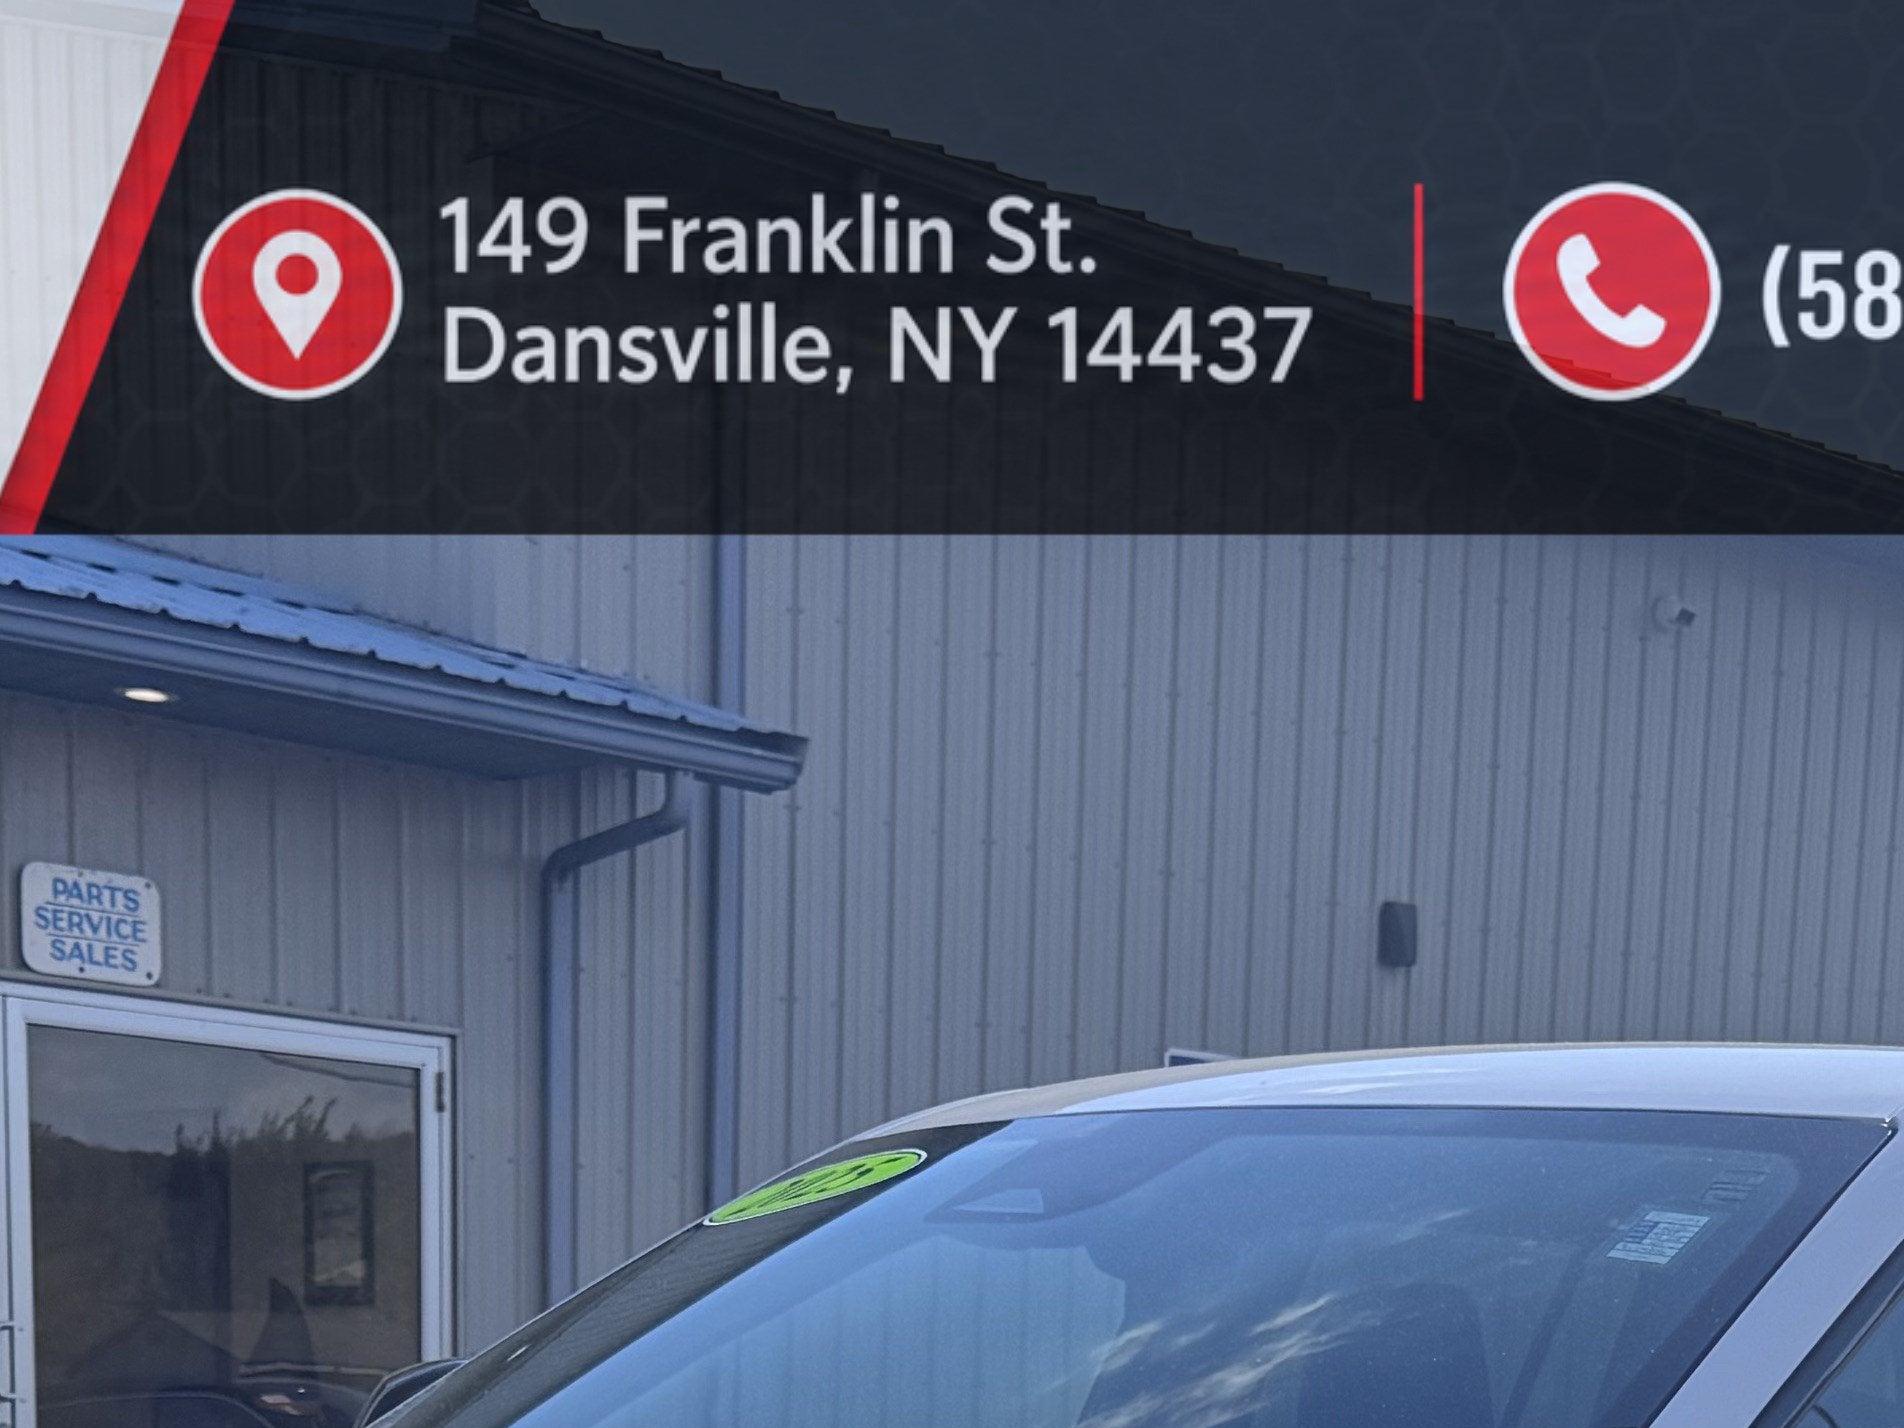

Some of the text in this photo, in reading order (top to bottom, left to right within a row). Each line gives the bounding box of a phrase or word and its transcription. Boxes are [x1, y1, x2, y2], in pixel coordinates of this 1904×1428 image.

[51, 876, 142, 913] PARTS
[34, 905, 148, 943] SERVICE
[49, 938, 139, 973] SALES
